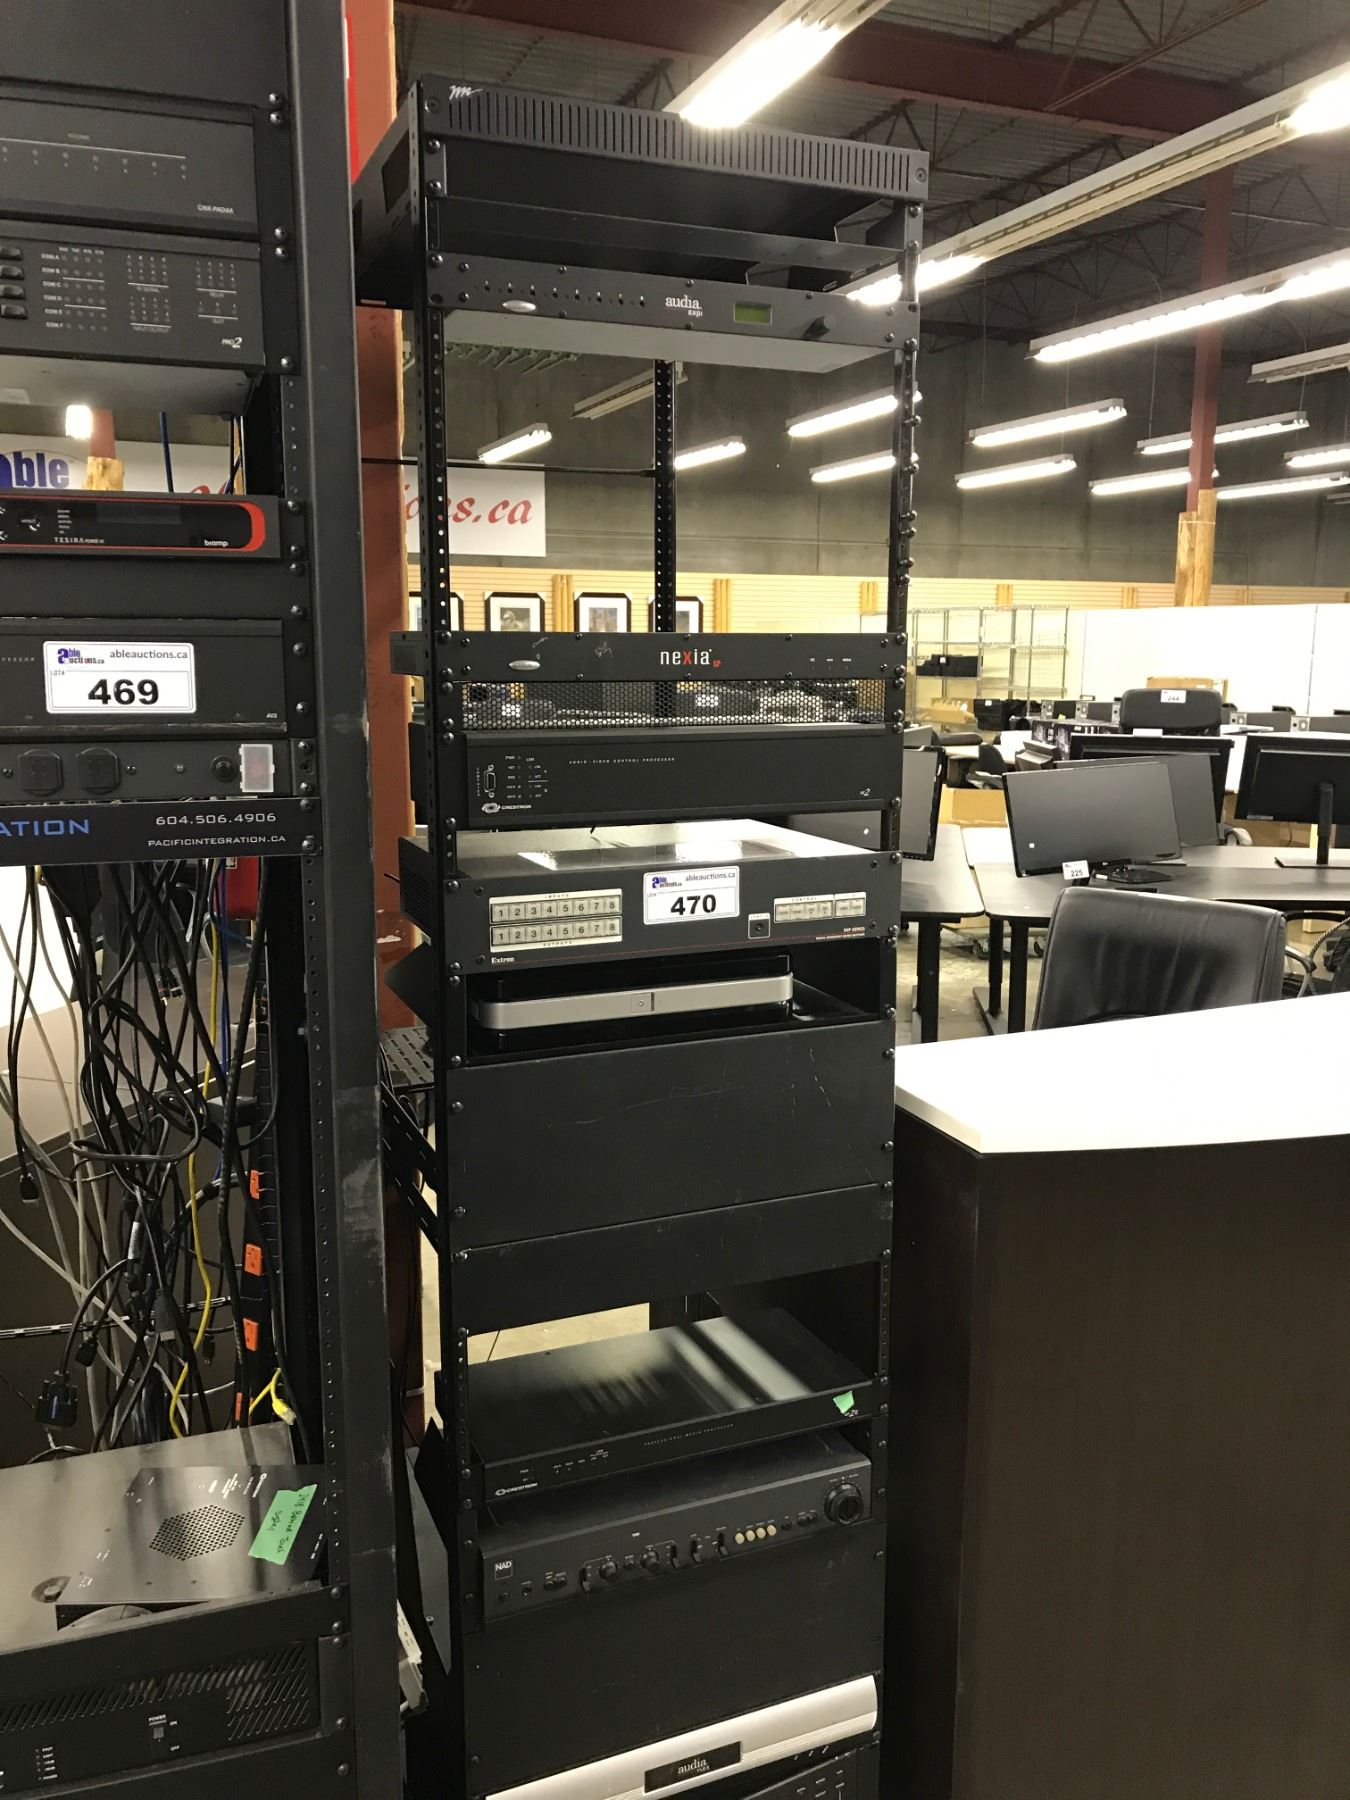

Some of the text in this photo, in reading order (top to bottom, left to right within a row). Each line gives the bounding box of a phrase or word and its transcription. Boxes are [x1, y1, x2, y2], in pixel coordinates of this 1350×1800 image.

[665, 294, 699, 309] audia
[204, 539, 229, 548] biamp
[109, 649, 188, 659] ableauctions.ca
[660, 649, 710, 665] nexia
[88, 679, 159, 705] 469
[155, 812, 277, 826] 604.506.4906
[147, 835, 286, 847] PACIFICINTEGRATION.CA
[685, 872, 736, 881] ableauctions.ca
[1070, 869, 1083, 877] 225
[670, 894, 717, 916] 470
[494, 1560, 513, 1571] NAD
[678, 1759, 707, 1774] audia
